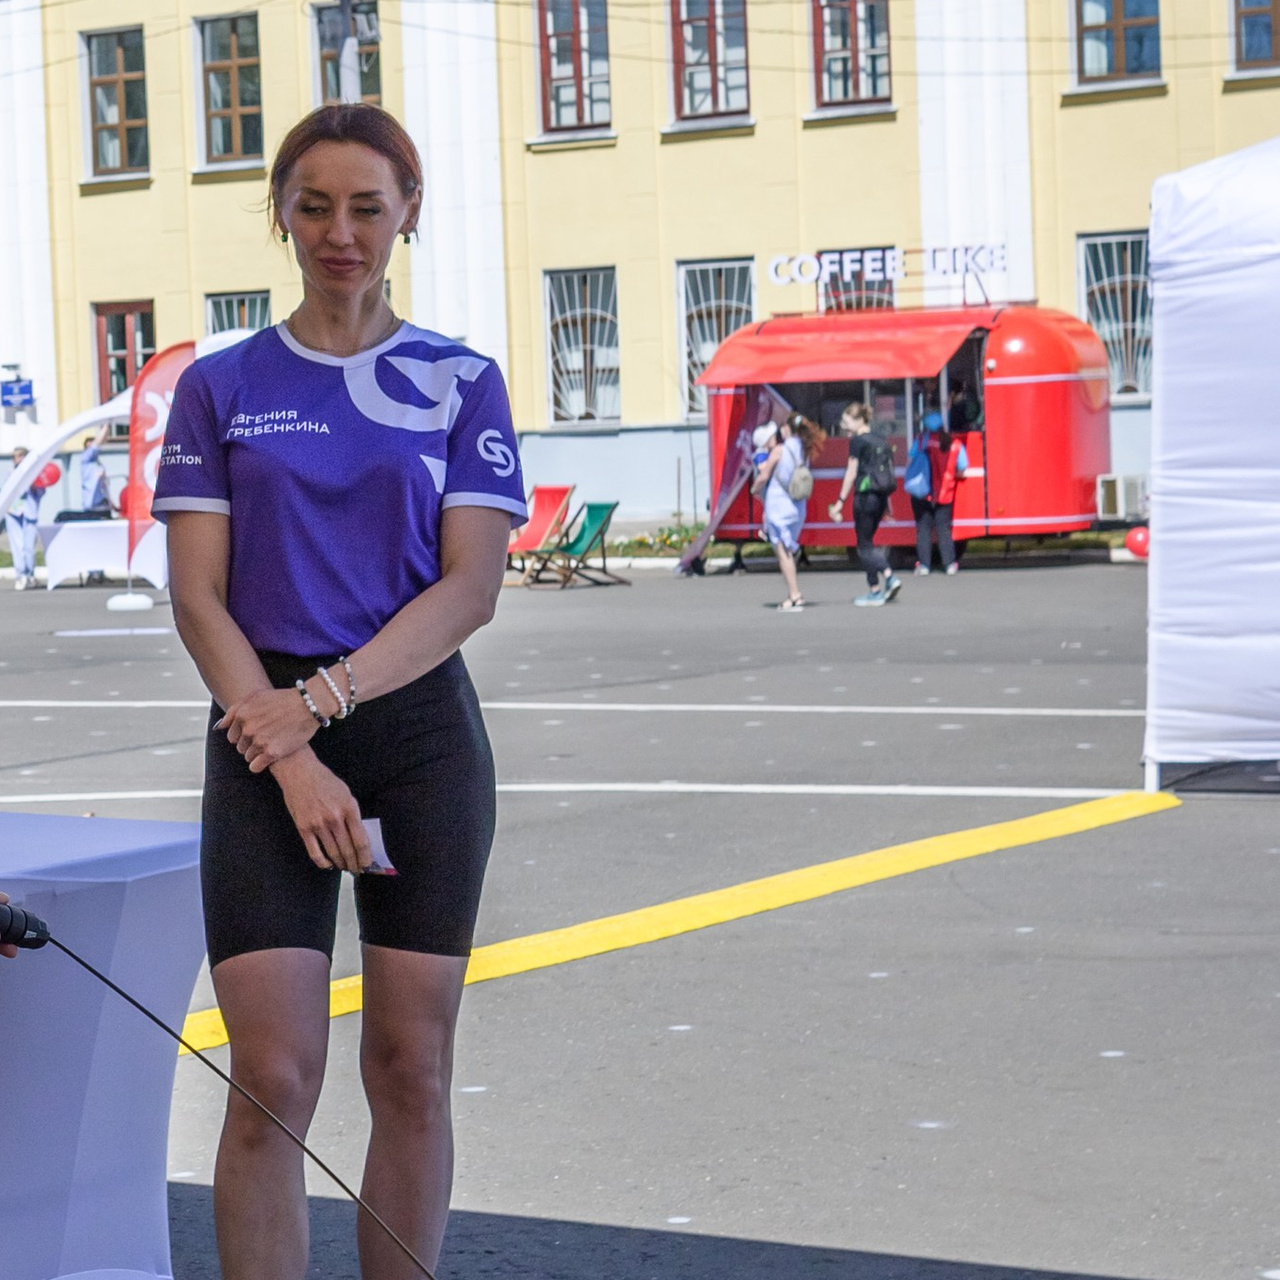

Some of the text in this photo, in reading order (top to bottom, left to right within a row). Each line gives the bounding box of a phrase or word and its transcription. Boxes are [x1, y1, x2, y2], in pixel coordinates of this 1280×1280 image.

[768, 243, 1006, 286] COFFEE LIKE
[226, 421, 330, 439] ГРЕБЕНКИНА
[162, 444, 181, 455] GYM
[160, 455, 202, 466] STATION
